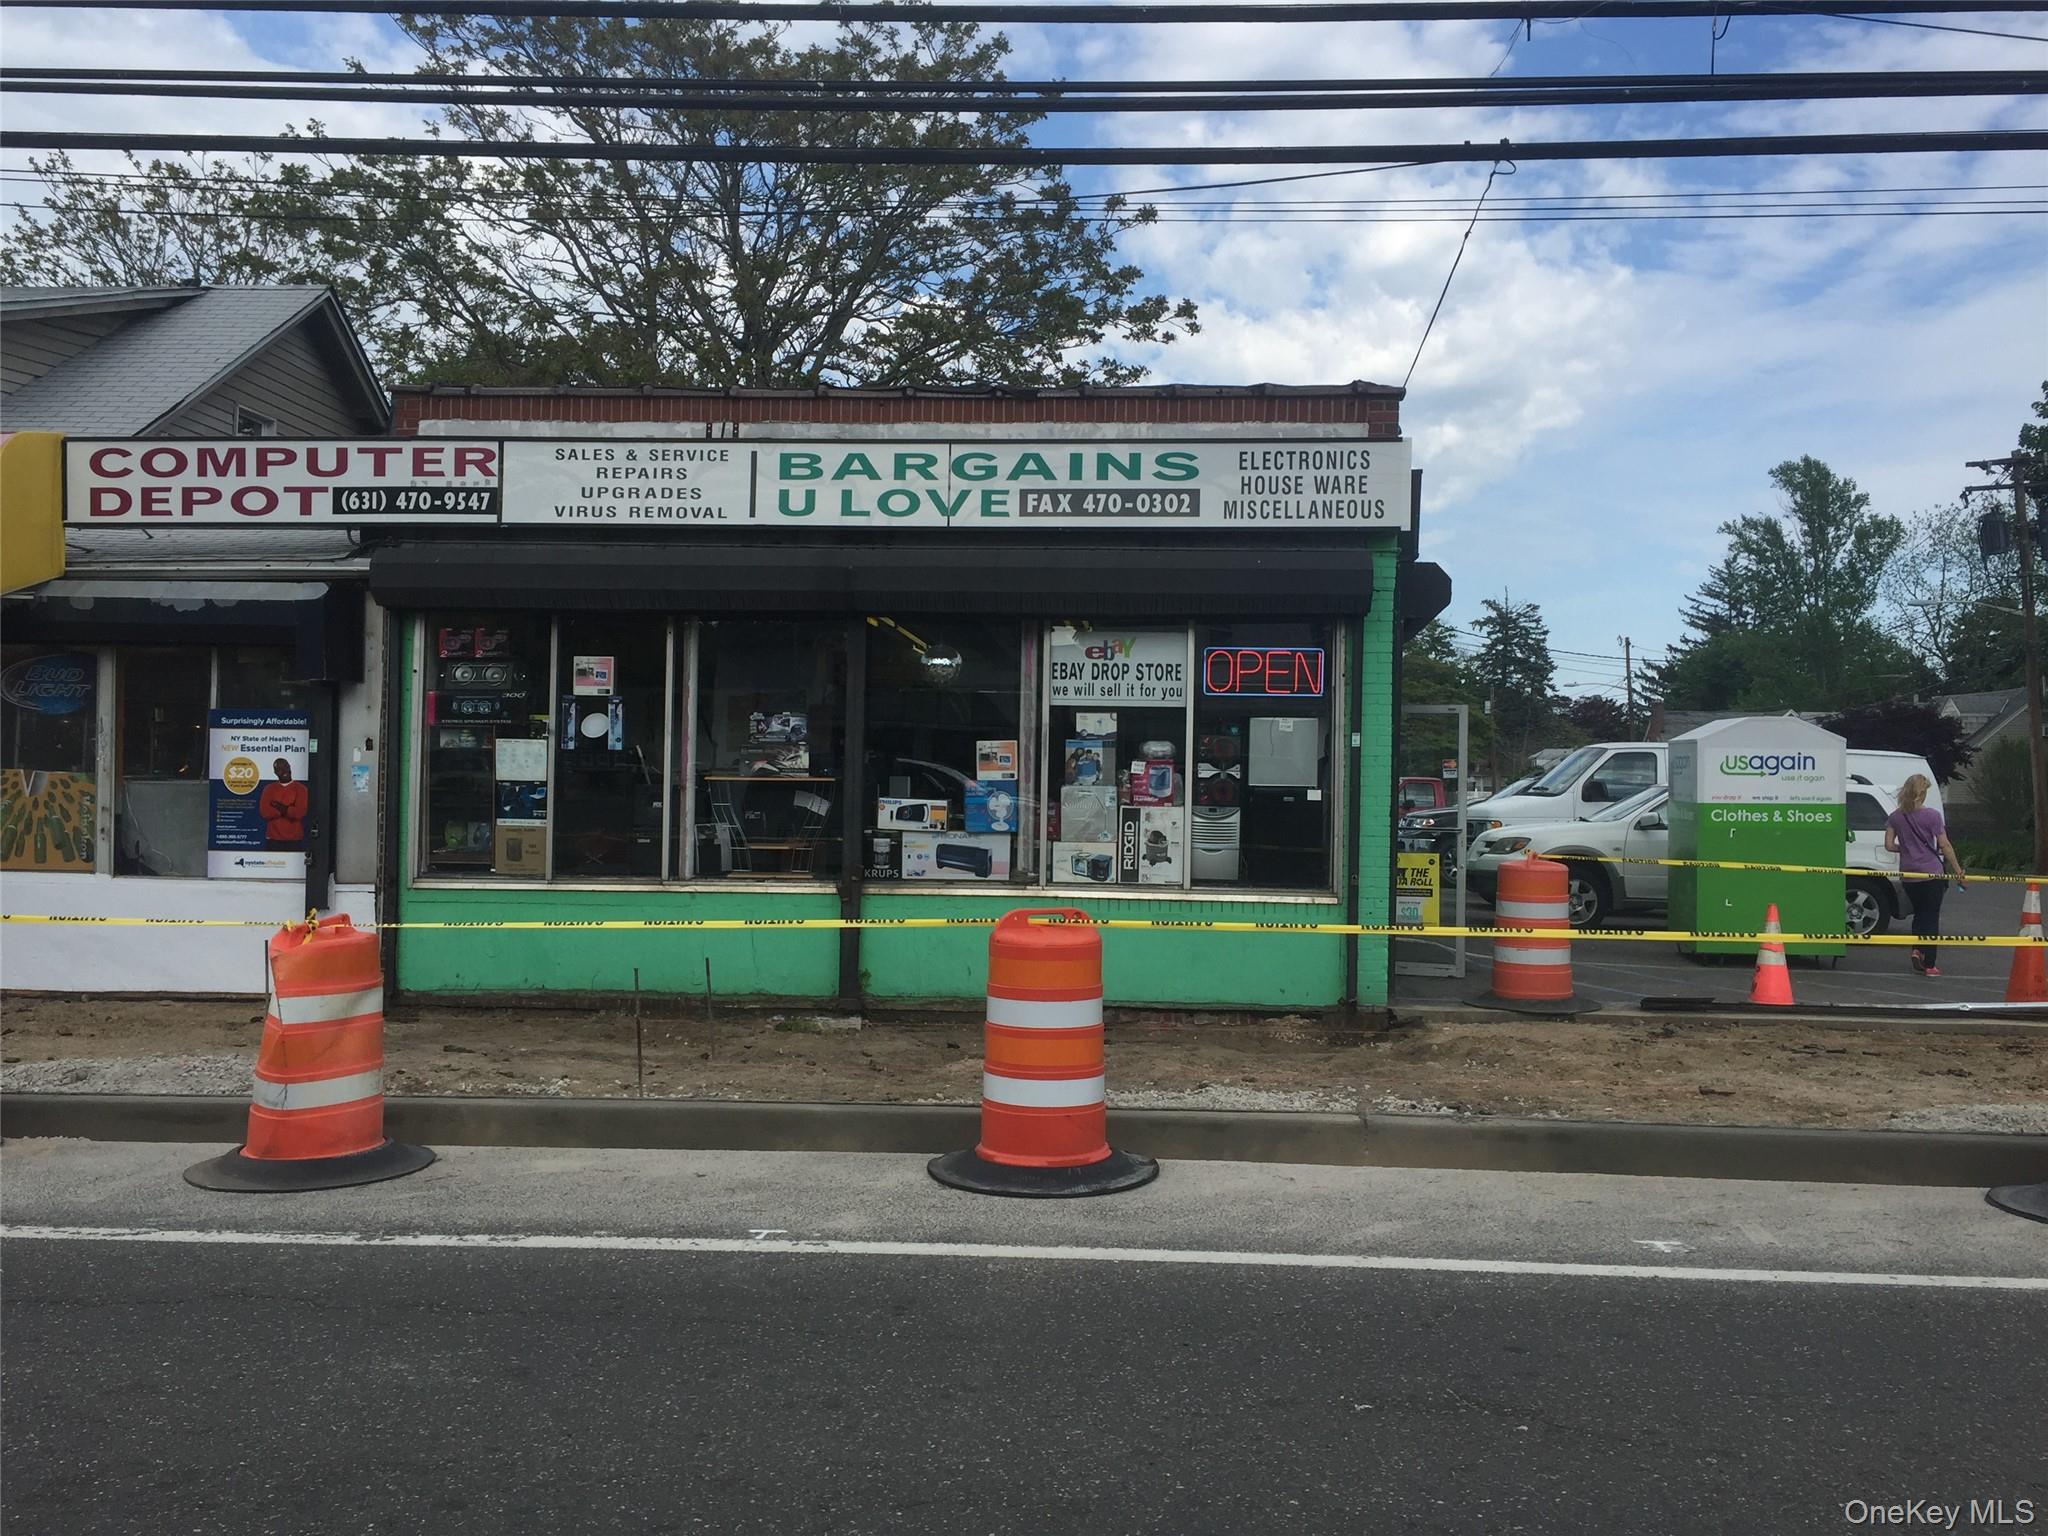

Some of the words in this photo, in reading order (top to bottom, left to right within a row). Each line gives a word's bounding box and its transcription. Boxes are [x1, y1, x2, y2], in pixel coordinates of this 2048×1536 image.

[89, 446, 498, 478] COMPUTER
[555, 448, 615, 462] SALES
[626, 448, 638, 461] &
[648, 448, 730, 462] SERVICE
[1238, 450, 1370, 471] ELECTRONICS
[596, 466, 688, 480] REPAIRS
[779, 452, 1200, 481] BARGAINS
[580, 486, 702, 500] UPGRADES
[1240, 475, 1304, 495] HOUSE
[1313, 475, 1368, 495] WARE
[89, 486, 328, 517] DEPOT
[341, 490, 386, 512] (631)
[395, 491, 491, 511] 470-9547
[778, 488, 816, 517] U
[840, 488, 1010, 517] LOVE
[1026, 493, 1073, 514] FAX
[1082, 493, 1191, 514] 470-0302
[1223, 499, 1386, 520] MISCELLANEOUS
[554, 505, 617, 519] VIRUS
[629, 505, 728, 519] REMOVAL
[25, 664, 85, 682] BUD
[1051, 662, 1085, 680] EBAY
[1091, 663, 1130, 681] DROP
[1135, 663, 1182, 681] STORE
[1207, 650, 1323, 694] OPEN
[12, 680, 92, 698] LIGHT
[1052, 686, 1069, 696] we
[1073, 682, 1095, 696] will
[1099, 683, 1121, 696] sell
[1126, 683, 1134, 696] it
[1140, 683, 1156, 696] for
[1161, 686, 1182, 700] you
[220, 717, 265, 726] Surprisingly
[266, 717, 307, 726] Affordable!
[240, 744, 282, 753] Essential
[285, 745, 306, 753] Plan
[228, 766, 254, 779] $20
[1725, 751, 1815, 776] usagain
[1804, 775, 1825, 783] again
[1711, 809, 1768, 822] Clothes
[1773, 810, 1783, 822] &
[1787, 809, 1832, 823] Shoes
[1123, 820, 1135, 870] RIDGID
[864, 869, 899, 878] KRUPS
[1410, 878, 1434, 886] ROLL
[1411, 868, 1430, 878] THE
